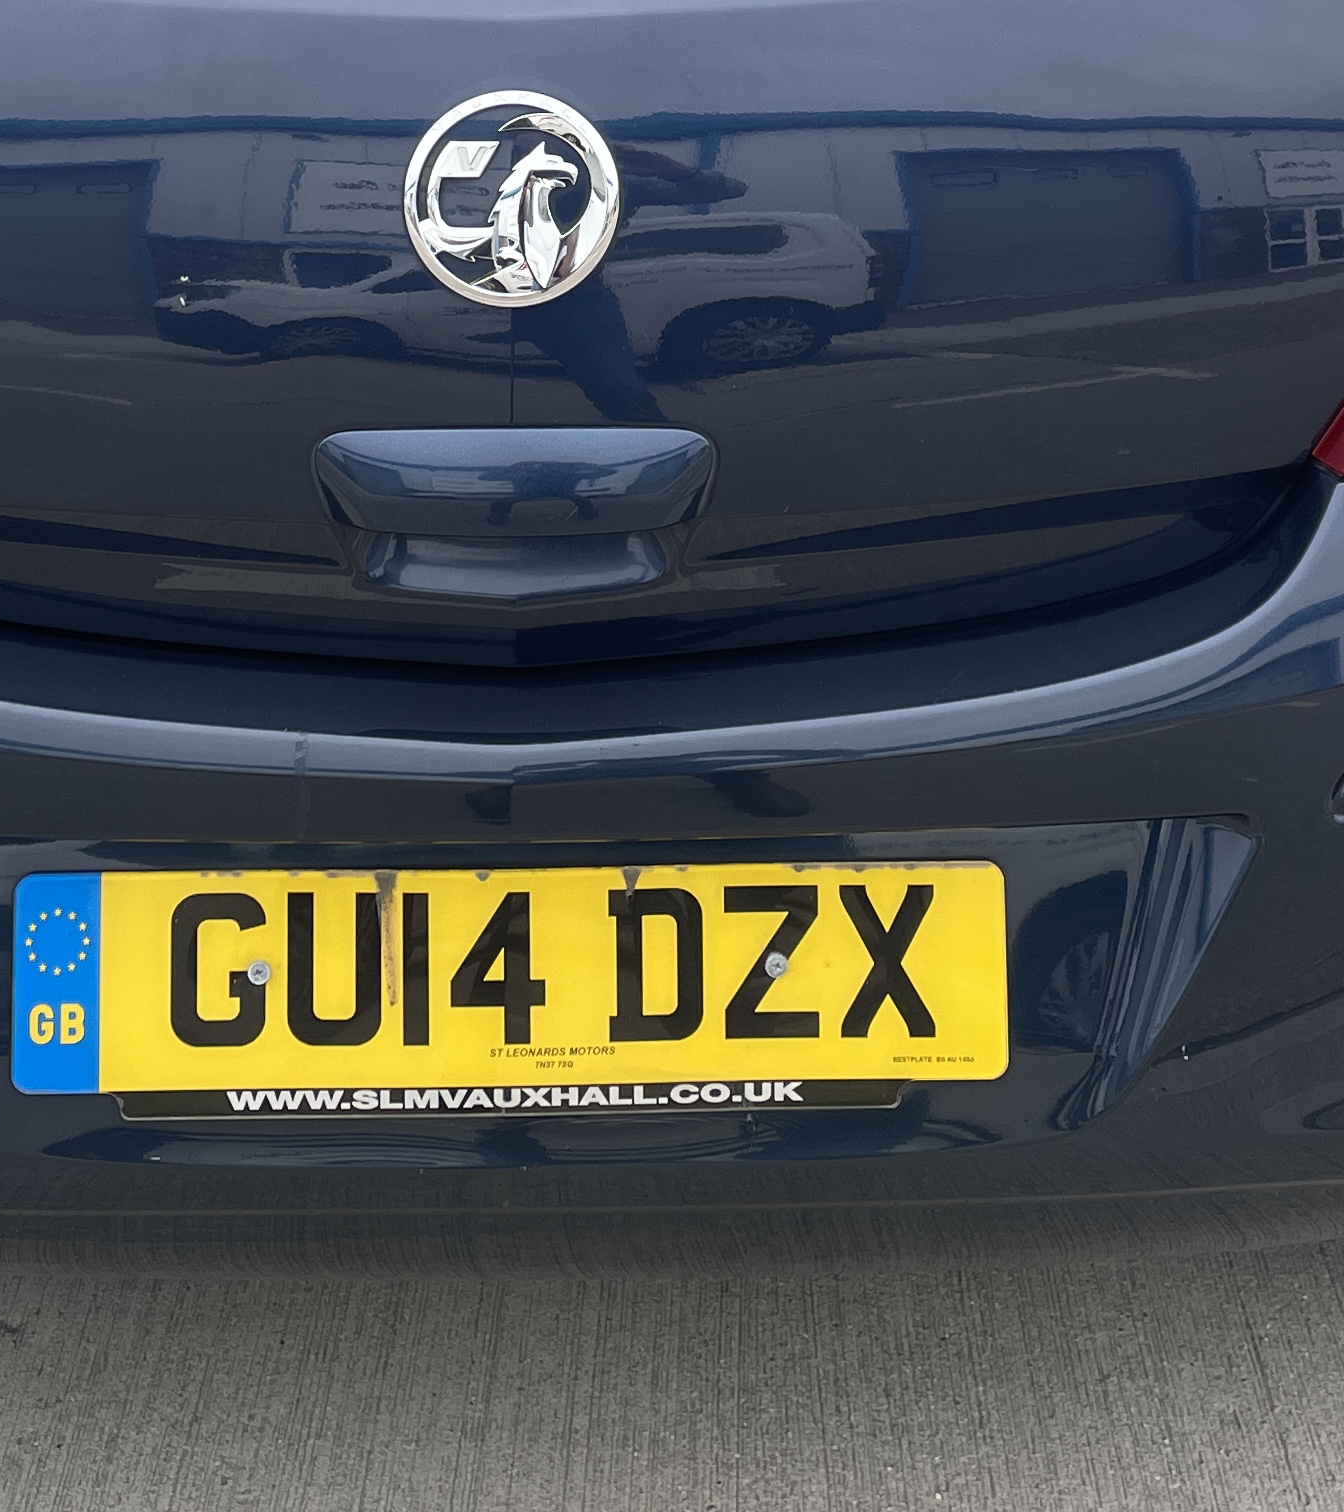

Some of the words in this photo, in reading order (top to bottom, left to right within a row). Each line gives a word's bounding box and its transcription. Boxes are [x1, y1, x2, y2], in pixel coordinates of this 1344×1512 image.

[170, 891, 546, 1048] GU14
[608, 884, 936, 1043] DZX
[28, 1003, 86, 1045] GB
[489, 1048, 504, 1058] ST
[505, 1047, 566, 1058] LEONARDS
[568, 1046, 616, 1056] MOTORS
[535, 1061, 555, 1069] TN37
[226, 1081, 804, 1112] WWW.SLMVAUXHALL.CO.UK
